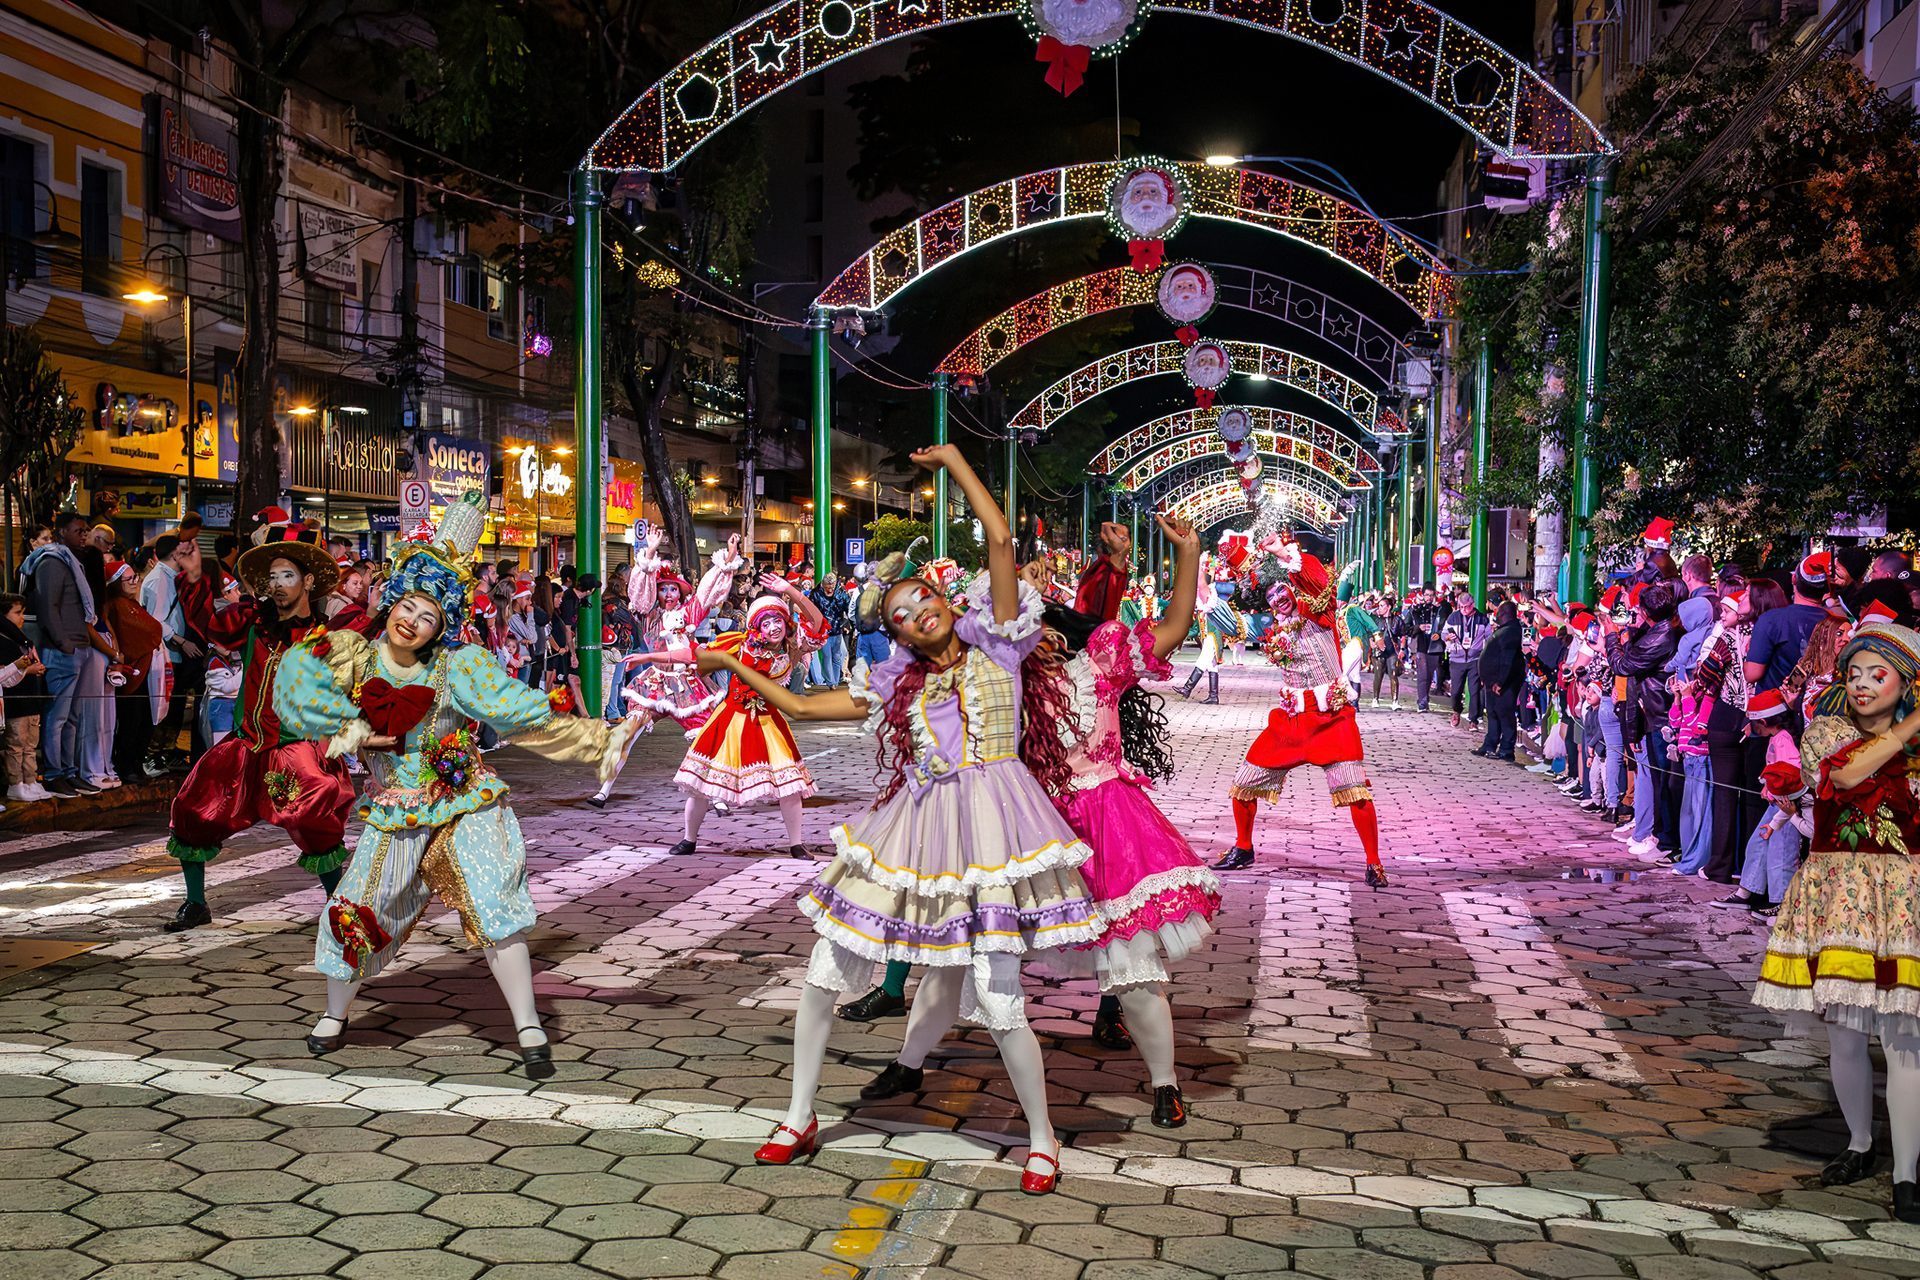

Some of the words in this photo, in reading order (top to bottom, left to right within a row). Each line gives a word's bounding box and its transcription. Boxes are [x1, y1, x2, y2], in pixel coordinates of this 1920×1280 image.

[428, 437, 484, 474] Soneca
[412, 489, 418, 501] E
[638, 523, 643, 536] E
[852, 542, 859, 554] P
